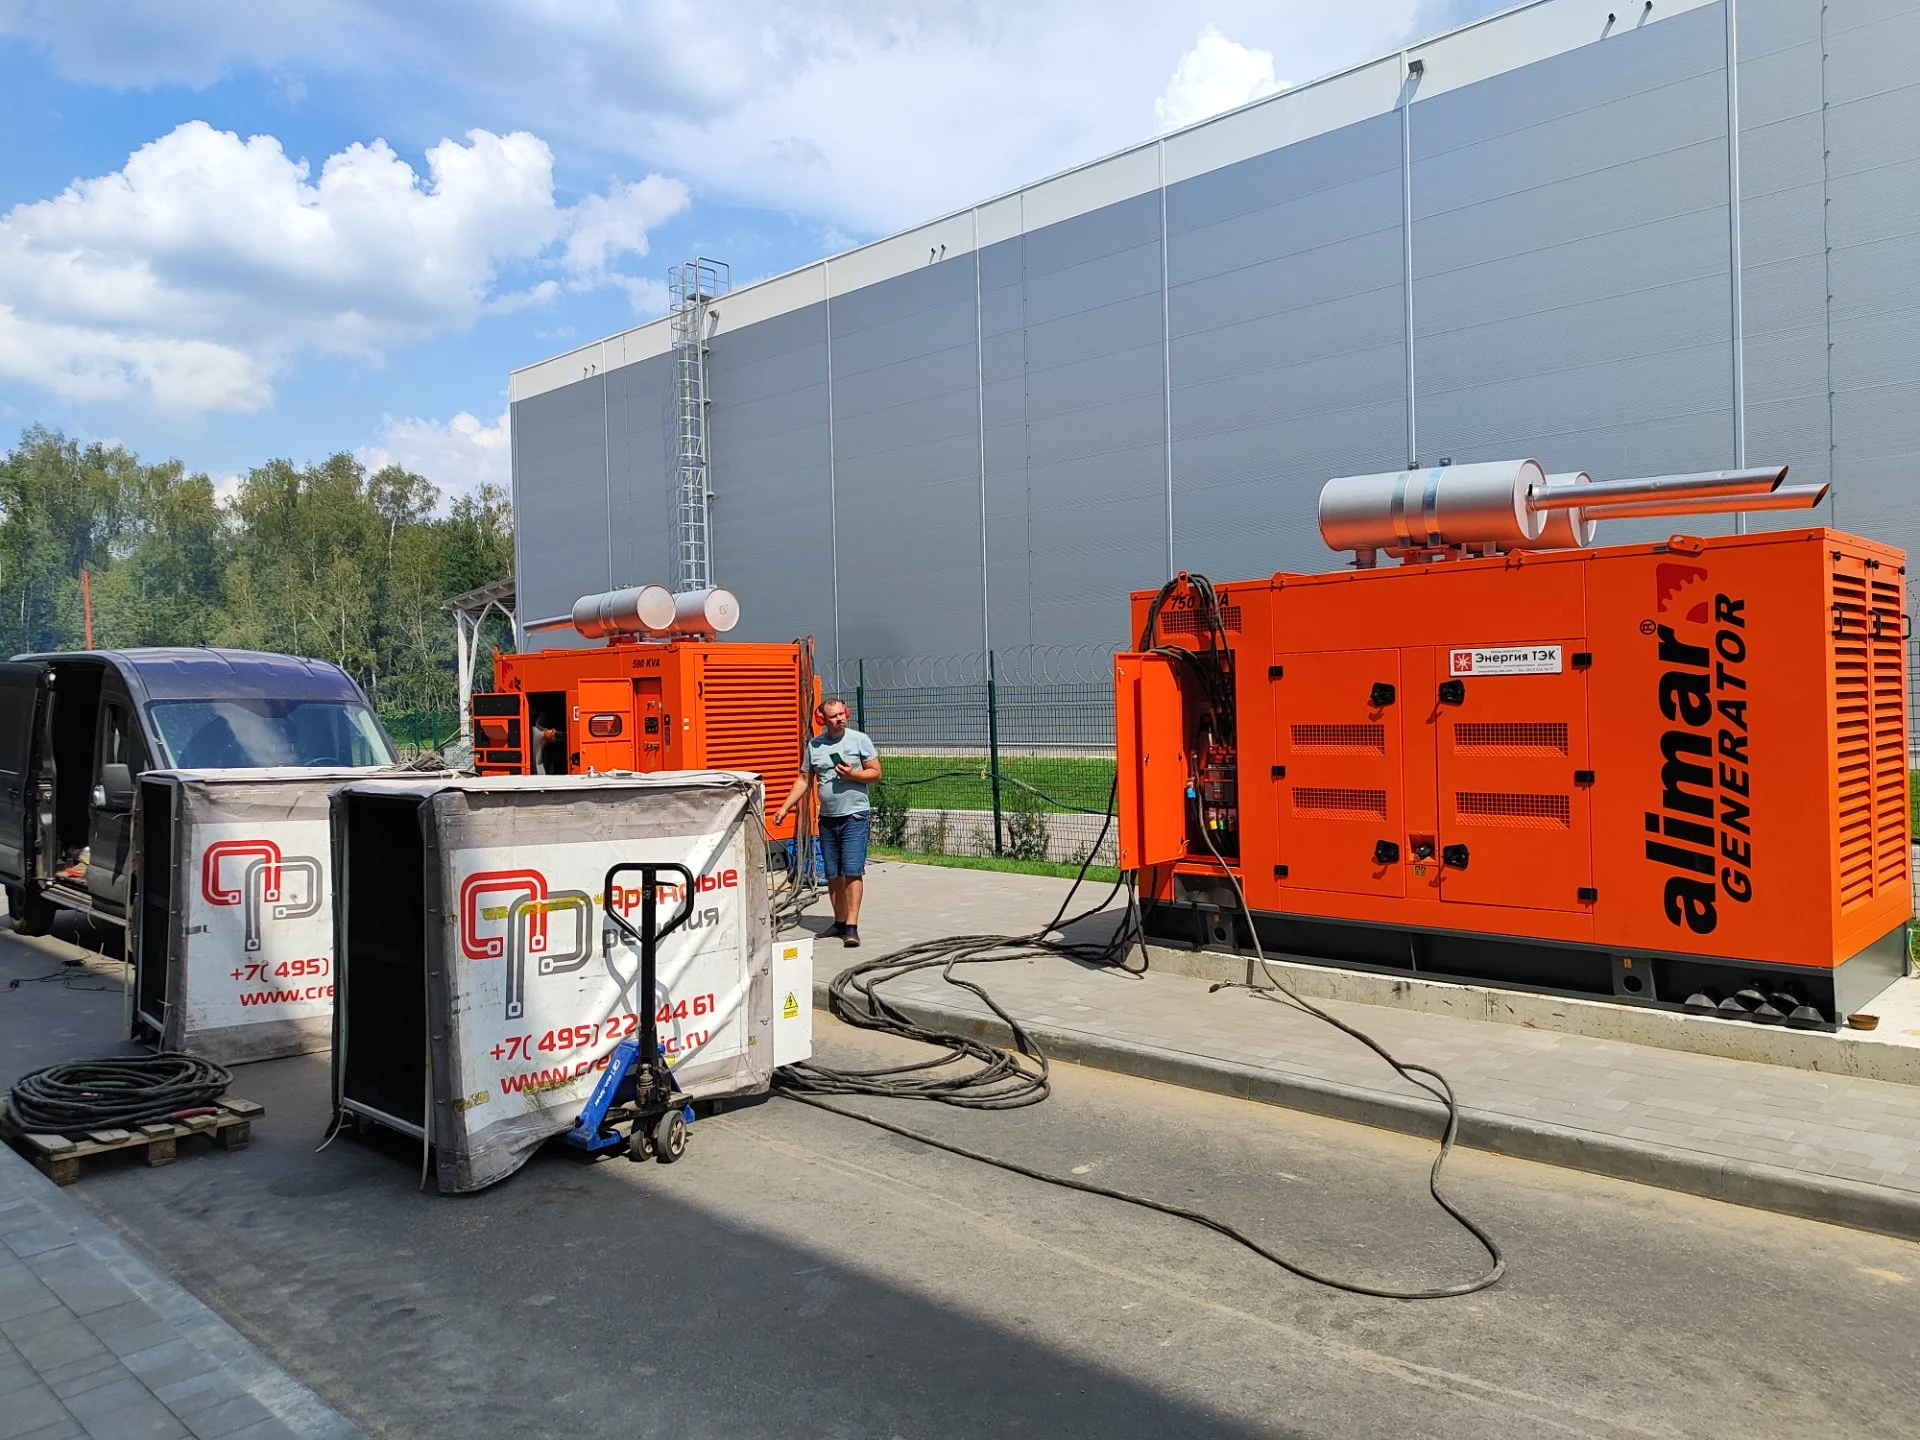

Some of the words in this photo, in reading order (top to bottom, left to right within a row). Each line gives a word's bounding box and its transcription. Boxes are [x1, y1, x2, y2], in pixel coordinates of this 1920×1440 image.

[1171, 595, 1195, 610] 750
[646, 658, 660, 668] KVA
[1475, 652, 1528, 664] Энергия
[1532, 650, 1556, 661] ТЭК
[1714, 593, 1752, 903] GENERATOR
[1645, 623, 1717, 934] alimar
[606, 1012, 640, 1040] 22
[655, 999, 688, 1024] 44
[693, 993, 715, 1016] 61
